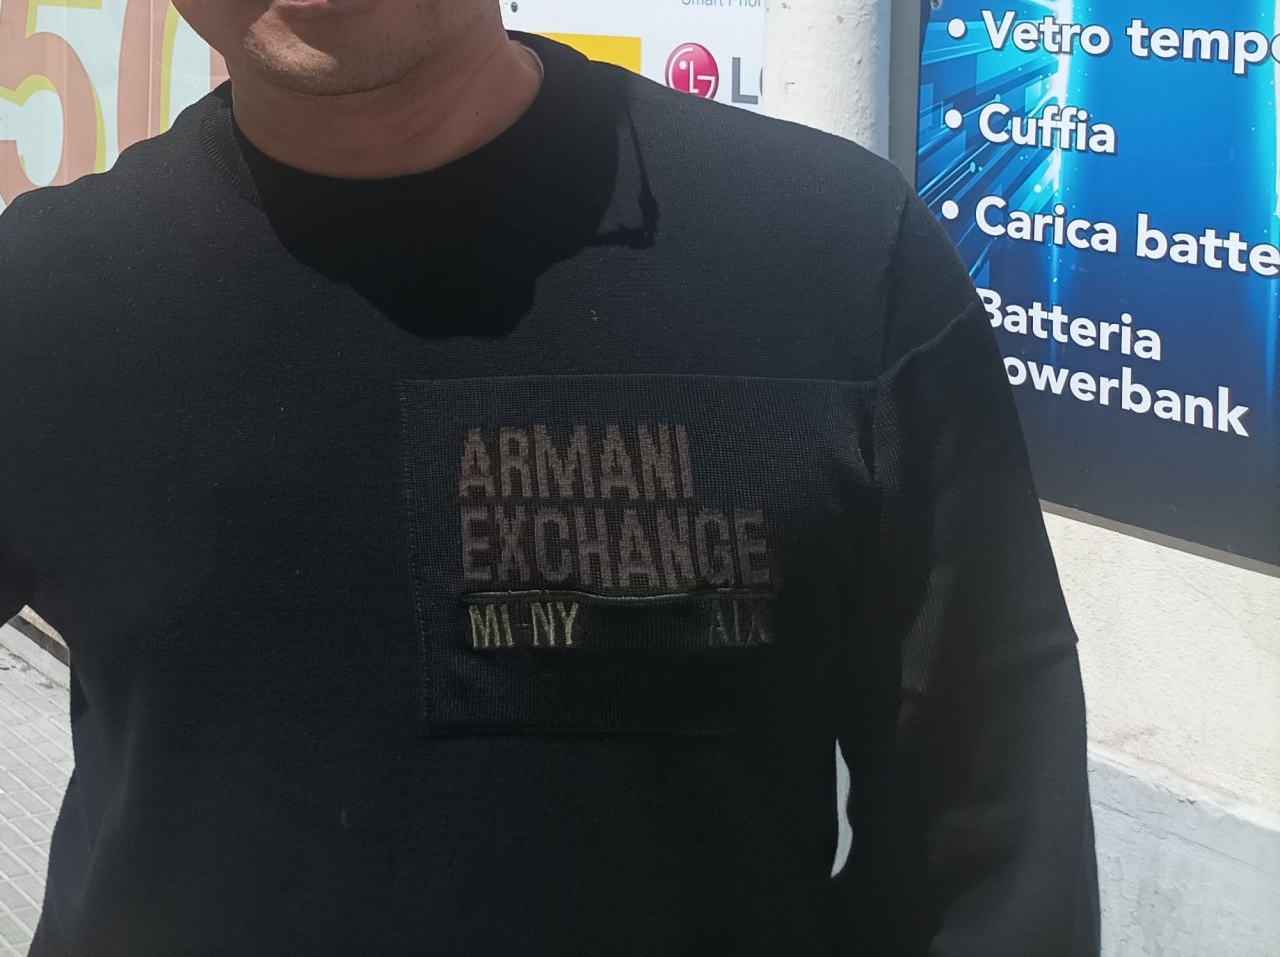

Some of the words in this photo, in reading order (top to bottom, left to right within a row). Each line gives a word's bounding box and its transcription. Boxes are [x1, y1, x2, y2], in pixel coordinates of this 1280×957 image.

[981, 9, 1111, 56] Vetro
[732, 56, 763, 105] L
[978, 102, 1117, 154] Cuffia
[975, 195, 1118, 254] Carica
[1136, 212, 1280, 276] batte
[975, 287, 1162, 361] Batteria
[459, 424, 695, 499] ARMANI
[462, 505, 770, 588] EXCHANGE
